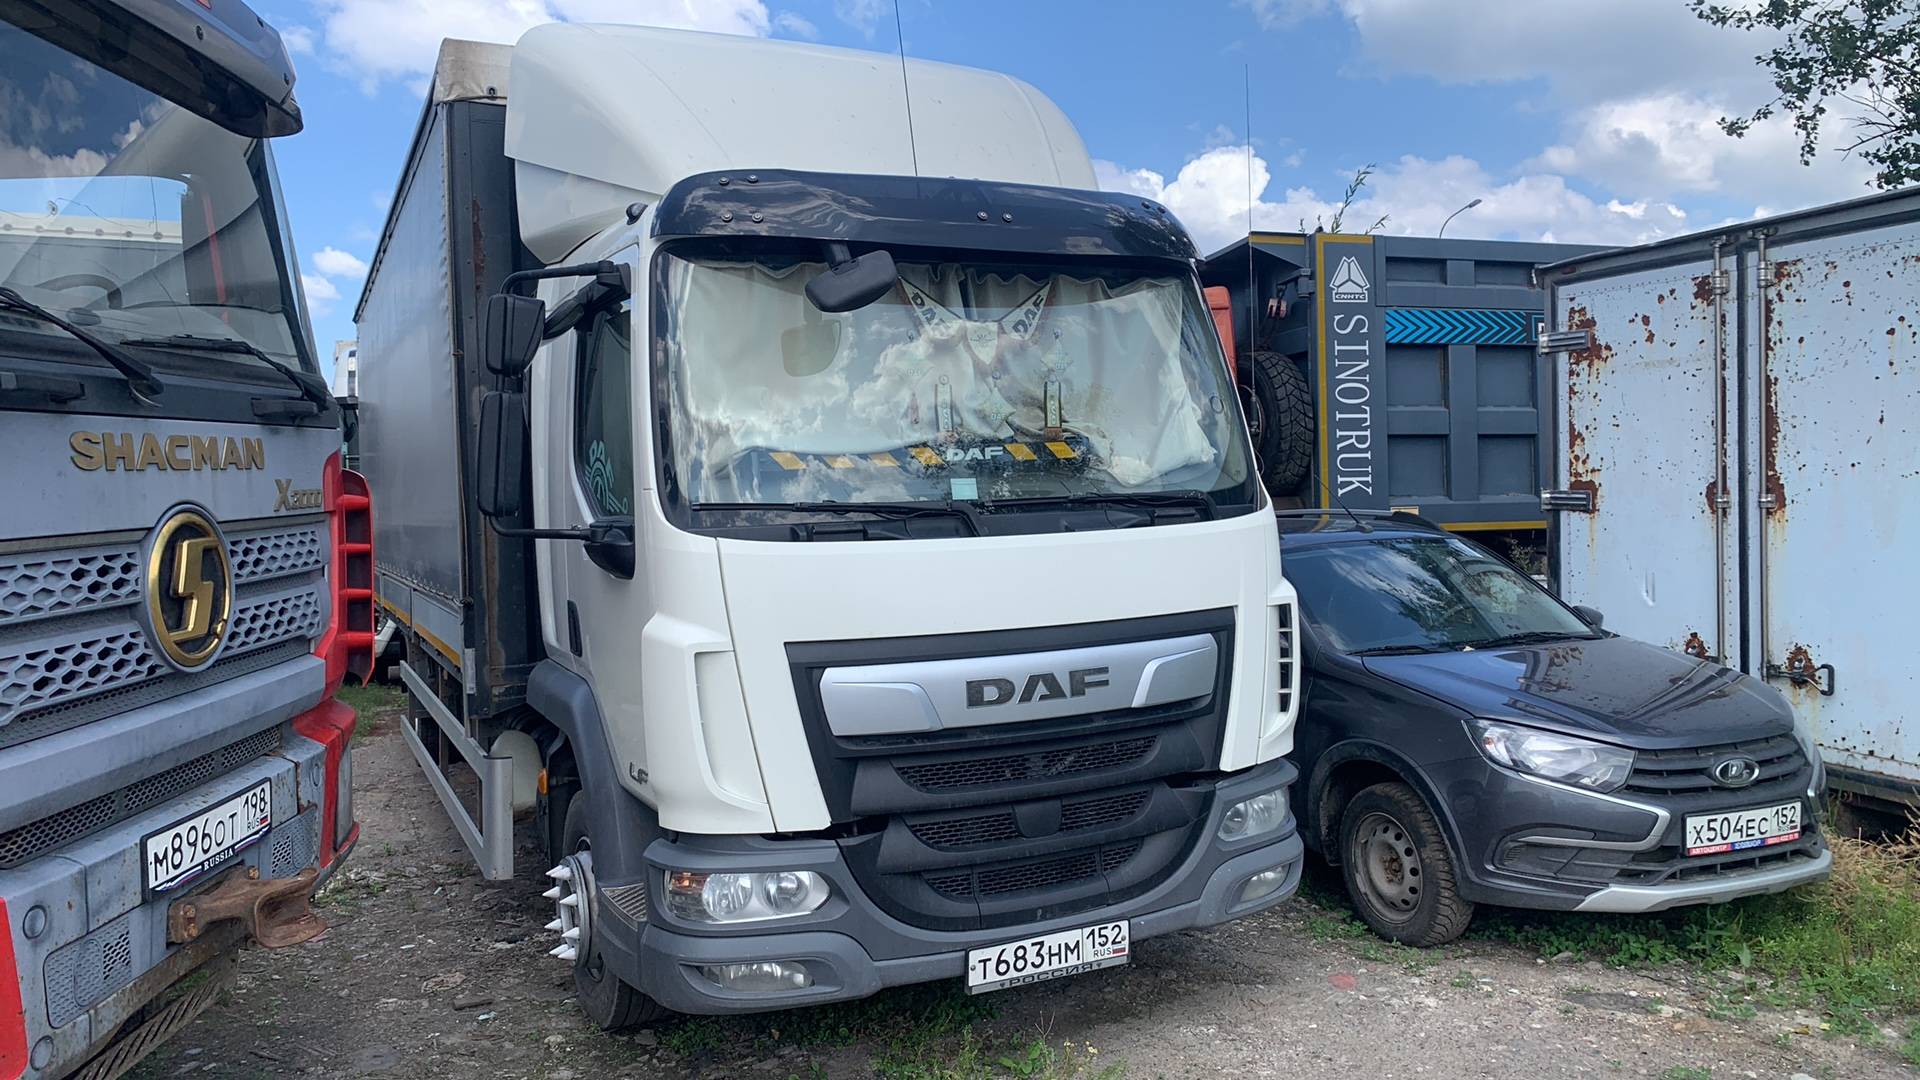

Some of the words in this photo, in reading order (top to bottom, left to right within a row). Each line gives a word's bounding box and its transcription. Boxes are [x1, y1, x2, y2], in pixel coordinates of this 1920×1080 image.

[1012, 294, 1044, 337] DAF
[1333, 314, 1372, 496] SINOTRUK
[70, 431, 265, 471] SHACMAN
[947, 446, 1003, 461] DAF
[966, 667, 1109, 709] DAF
[153, 811, 237, 881] М896ОТ
[243, 787, 268, 821] 198
[247, 817, 260, 832] RUS
[1693, 815, 1769, 845] Х504ЕС
[1773, 806, 1797, 826] 152
[204, 847, 234, 871] RUSSIA
[978, 940, 1081, 980] Т683НМ
[1086, 924, 1123, 949] 152
[1093, 947, 1112, 958] RUS
[1009, 963, 1093, 987] РОССИЯ
